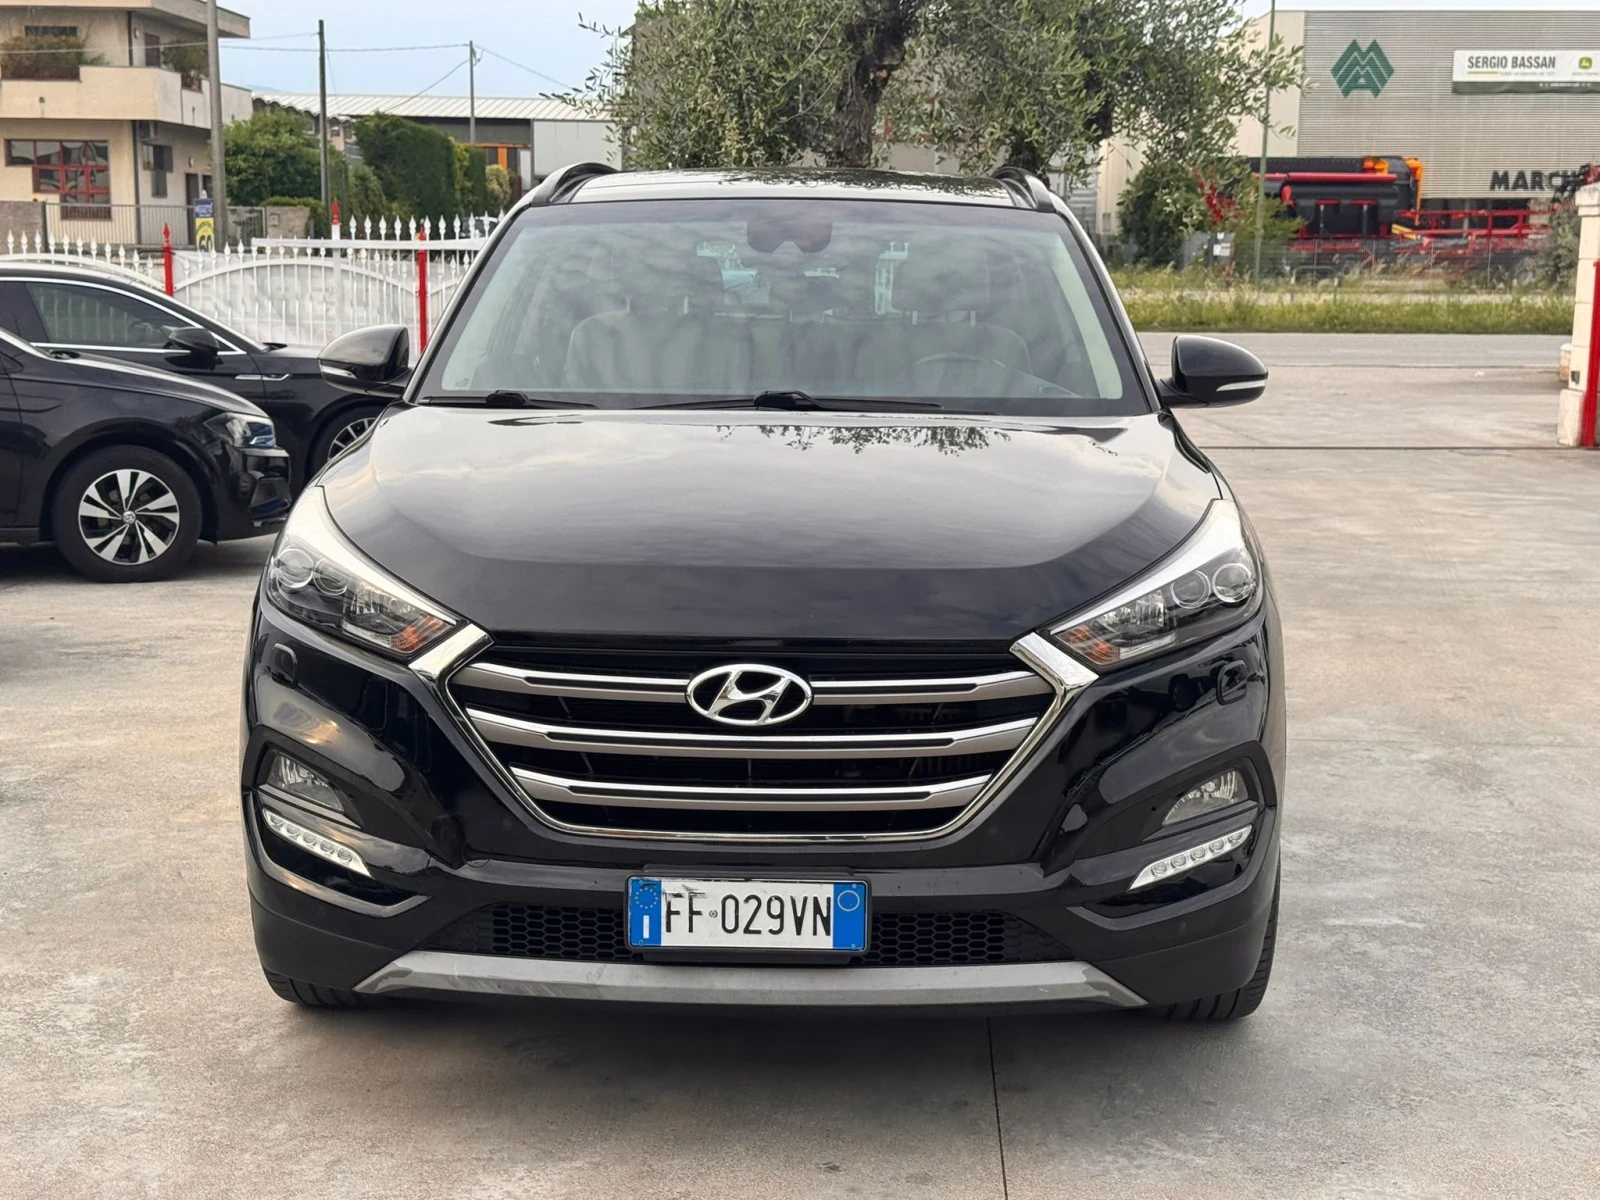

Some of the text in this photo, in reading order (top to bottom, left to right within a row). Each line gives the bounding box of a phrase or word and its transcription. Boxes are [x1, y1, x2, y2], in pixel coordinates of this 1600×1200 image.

[1467, 56, 1556, 69] SERGIO BASSAN
[1489, 170, 1577, 190] MARC
